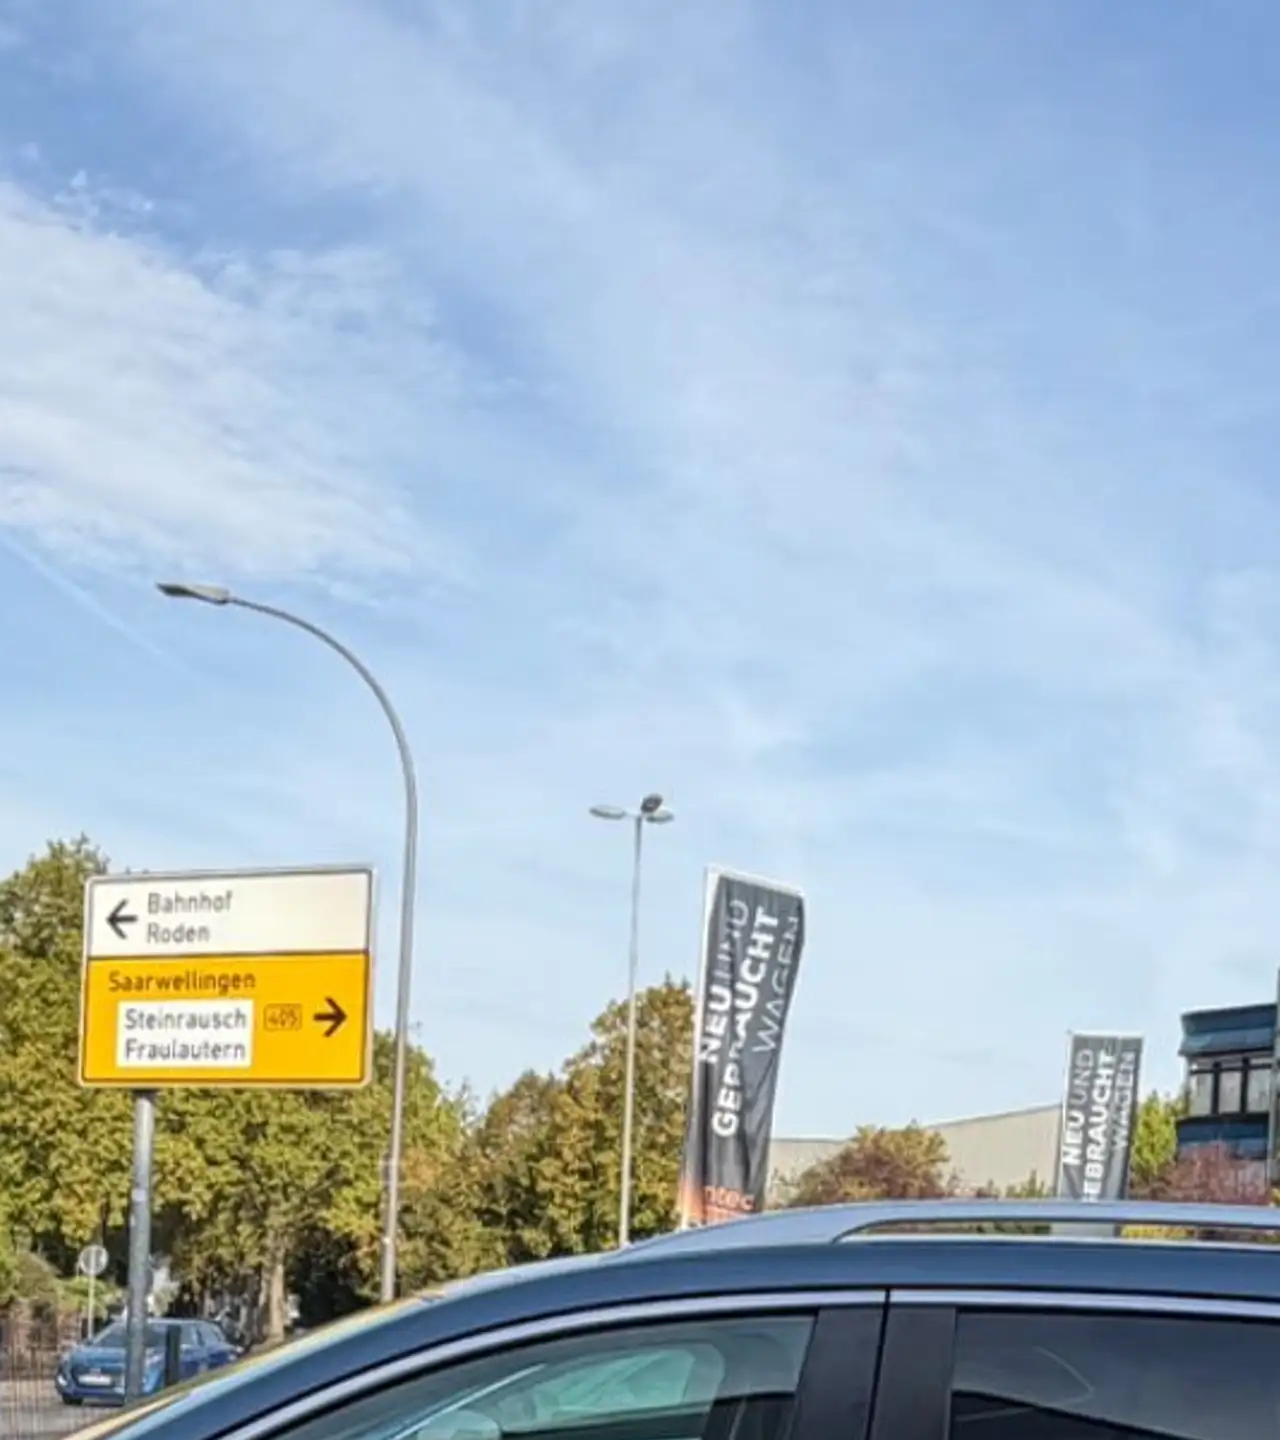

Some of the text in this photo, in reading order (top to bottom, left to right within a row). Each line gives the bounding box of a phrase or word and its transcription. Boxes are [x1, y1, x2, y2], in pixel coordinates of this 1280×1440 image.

[146, 889, 233, 915] Bahnhof
[145, 922, 211, 945] Roden
[108, 970, 257, 996] Saarwellingen
[124, 1005, 247, 1031] Steinrausch
[698, 984, 732, 1064] NEU
[124, 1037, 247, 1061] Fraulautern
[1061, 1048, 1094, 1166] NEU UND
